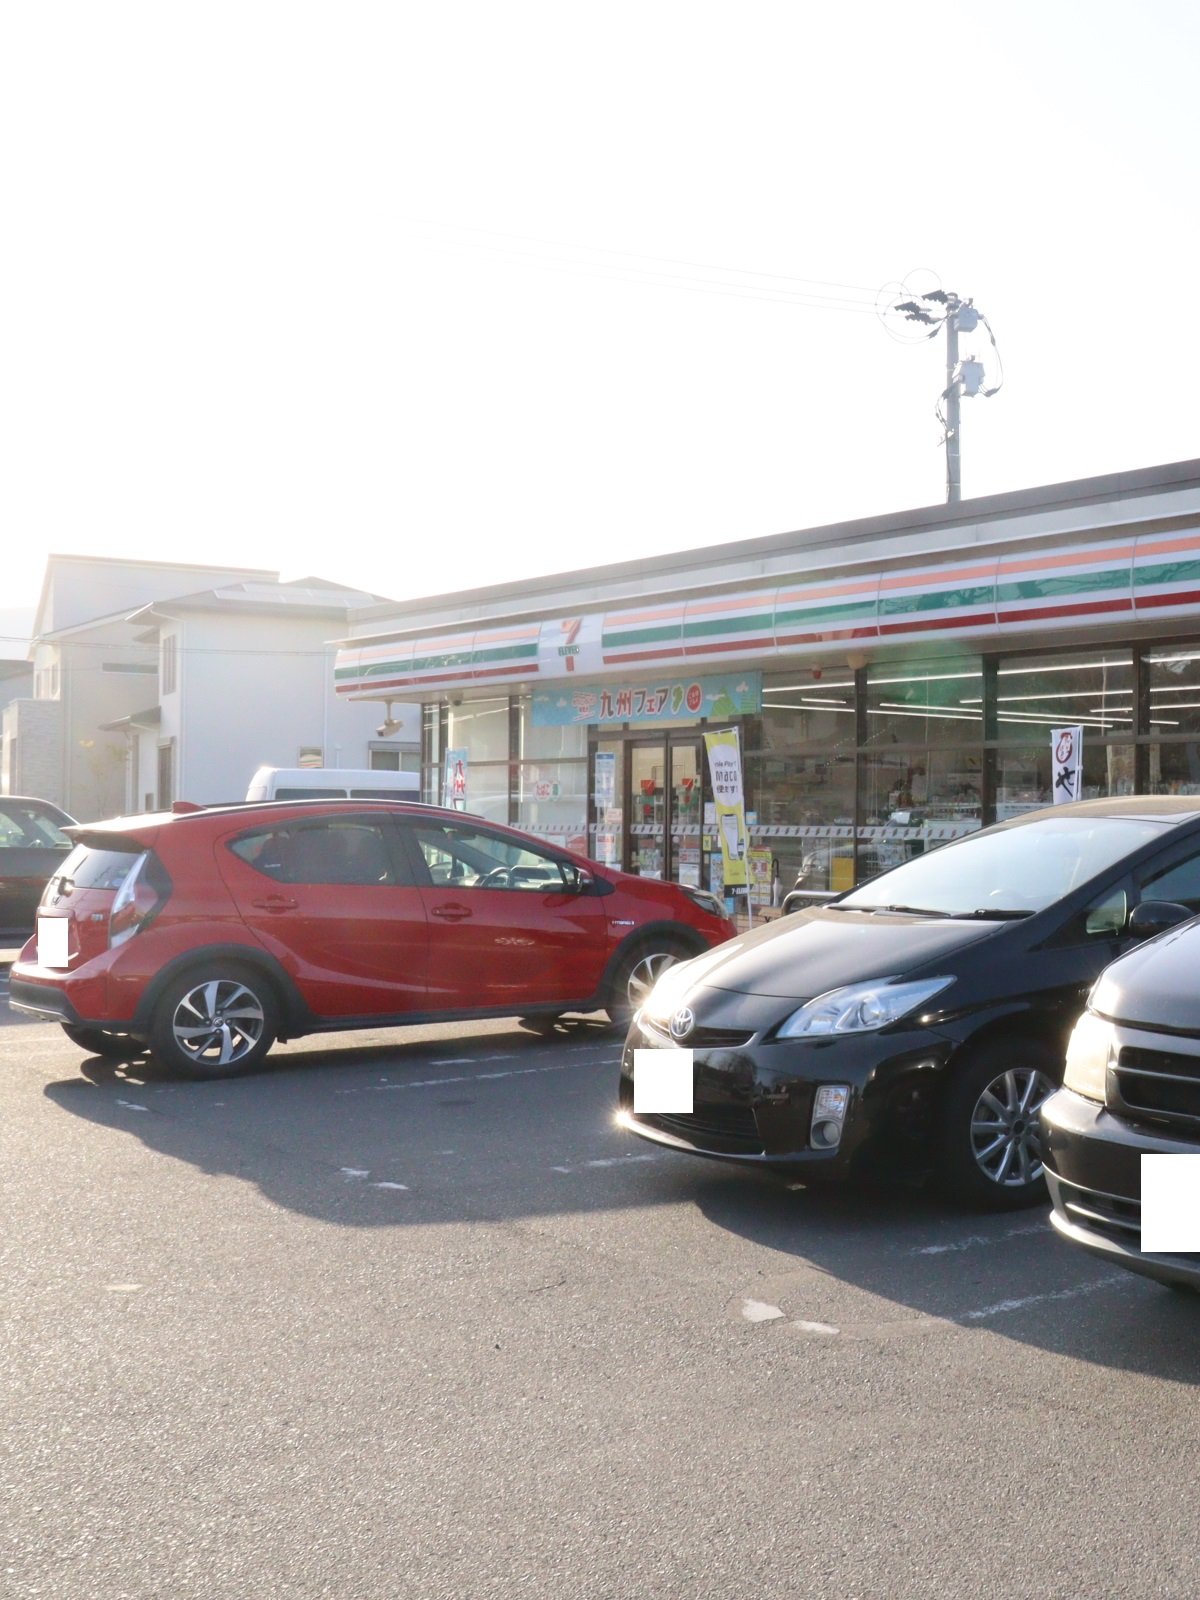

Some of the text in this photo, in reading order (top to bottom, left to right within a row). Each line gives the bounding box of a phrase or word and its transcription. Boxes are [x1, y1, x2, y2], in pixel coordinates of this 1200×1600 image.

[600, 688, 670, 718] 九州フェア
